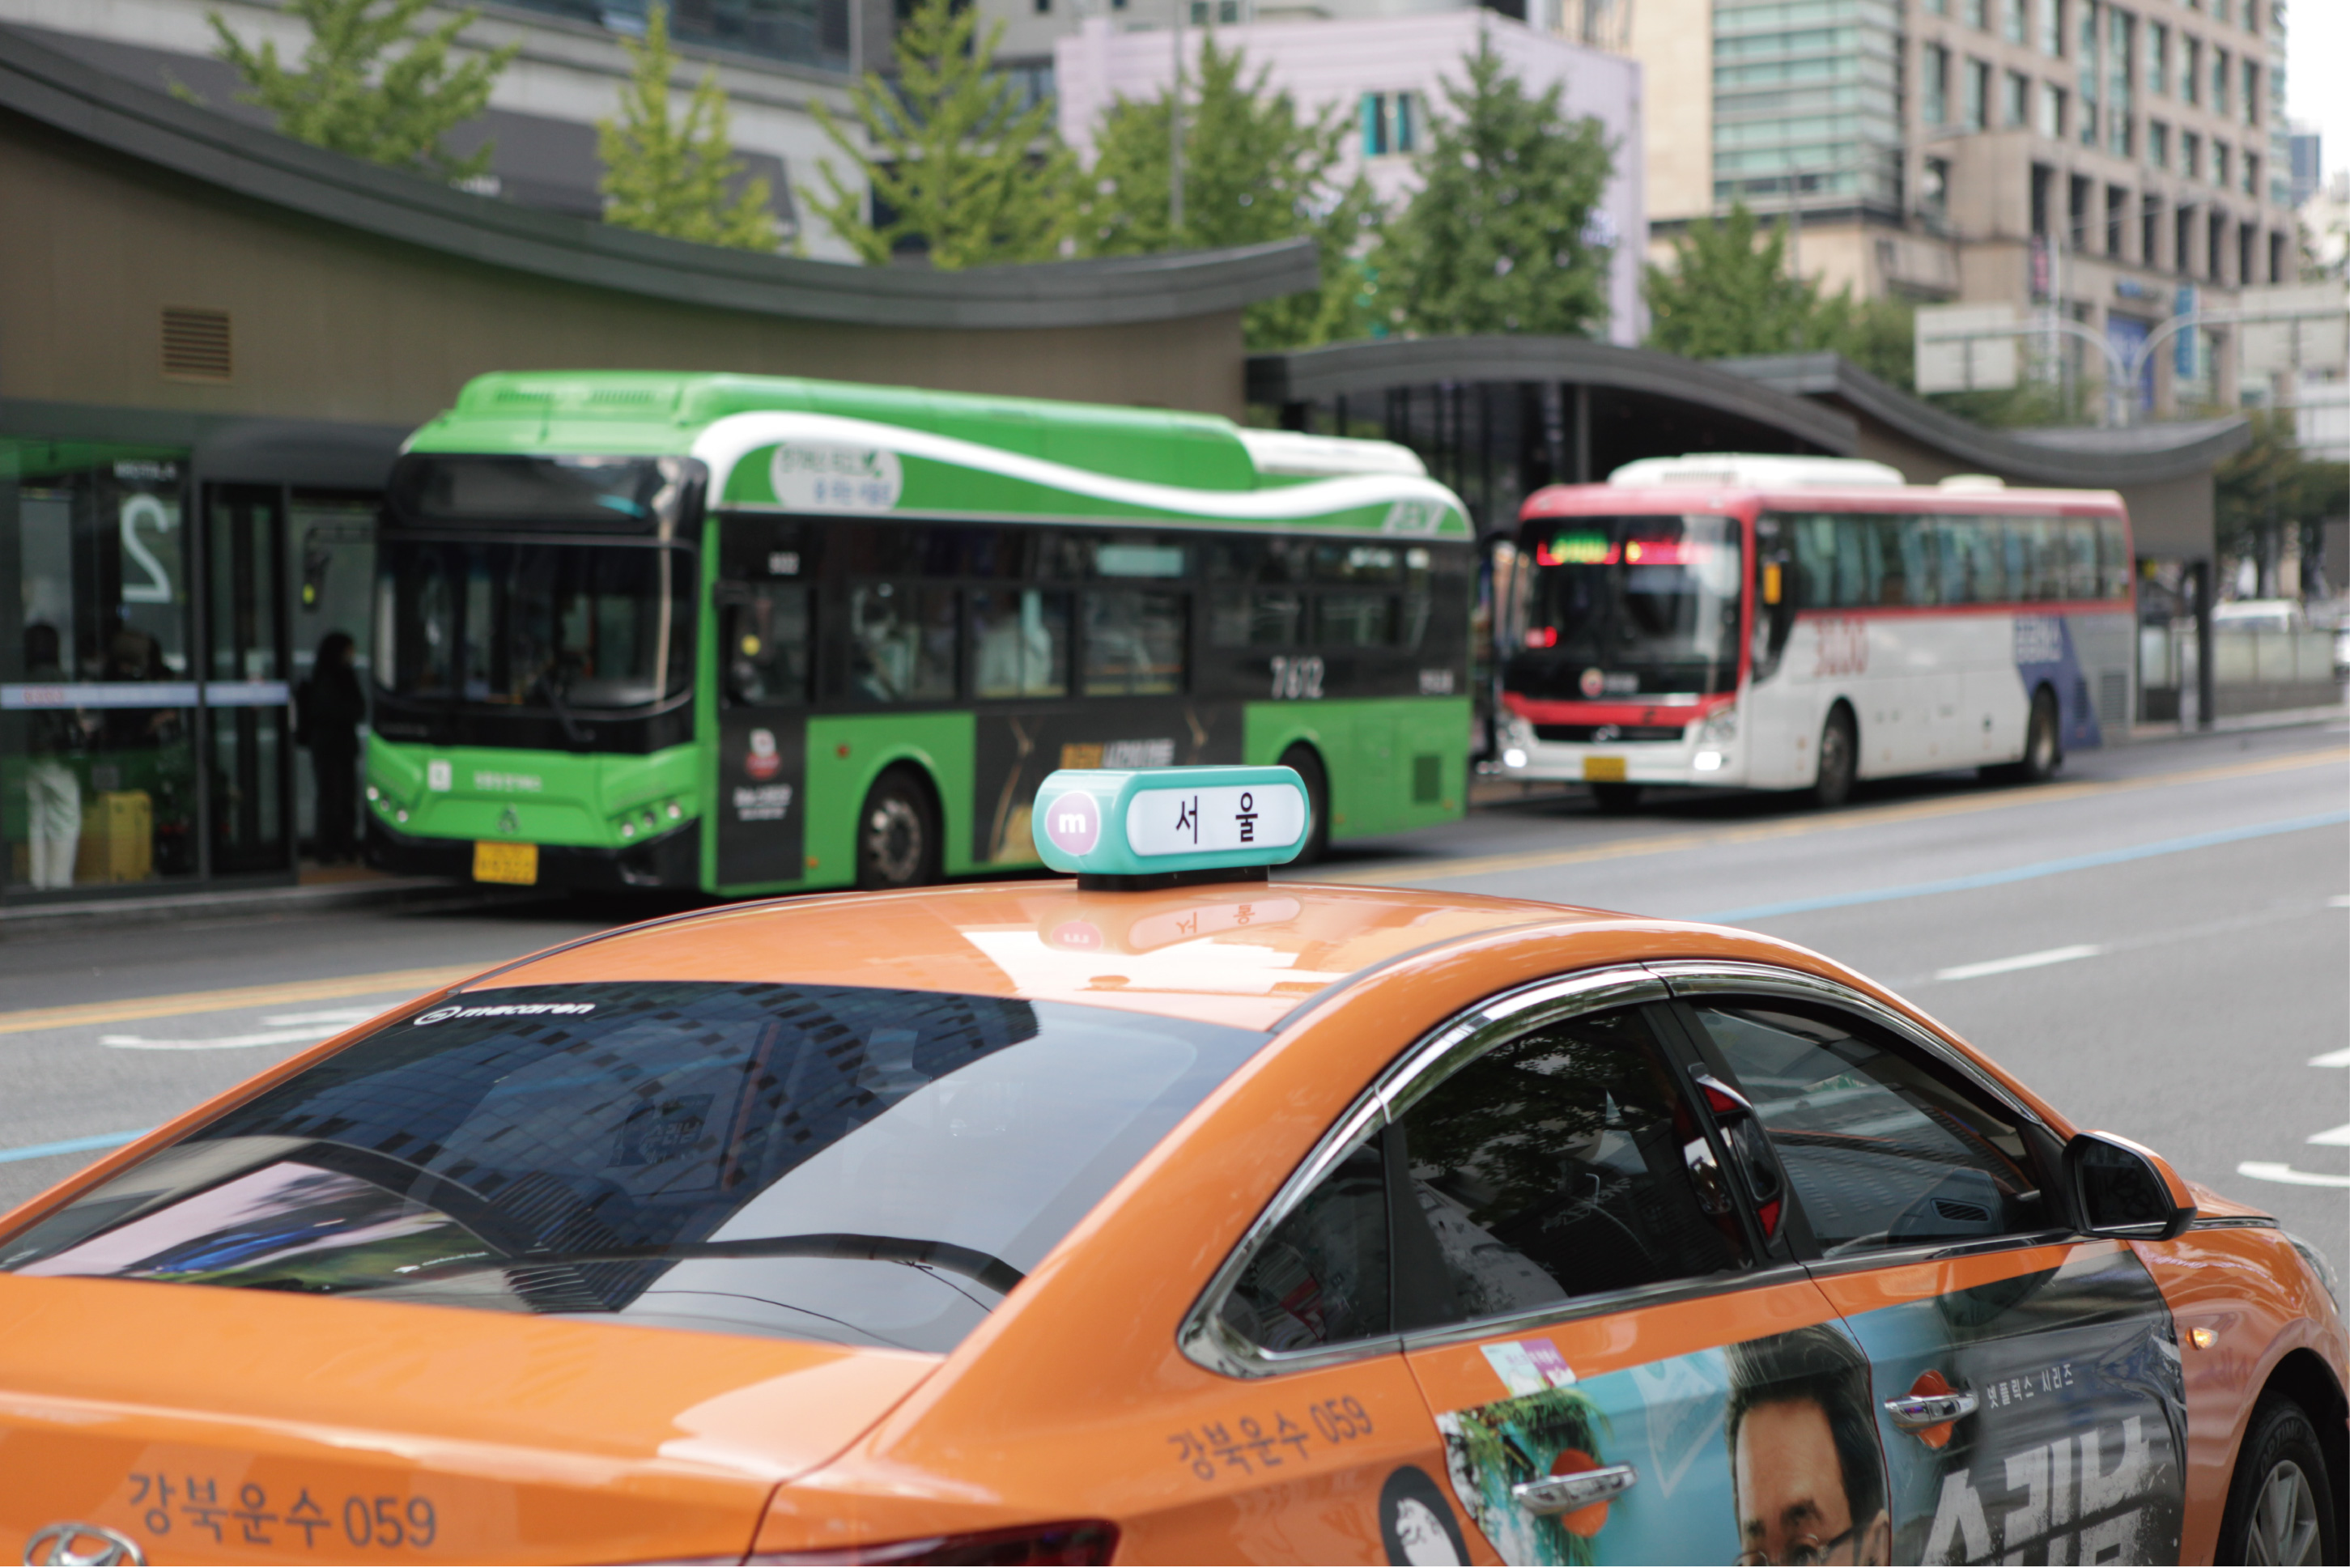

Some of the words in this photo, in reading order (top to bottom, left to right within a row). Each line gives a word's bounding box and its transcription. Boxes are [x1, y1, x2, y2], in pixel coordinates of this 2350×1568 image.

[1058, 813, 1086, 834] m
[455, 1003, 596, 1018] macaron
[1987, 1375, 2034, 1409] 넷플릭스
[2041, 1363, 2074, 1392] 시리즈
[1167, 1410, 1310, 1481] 강북운수
[1309, 1395, 1374, 1444] 059
[128, 1473, 332, 1549] 강북운수
[342, 1496, 437, 1549] 059
